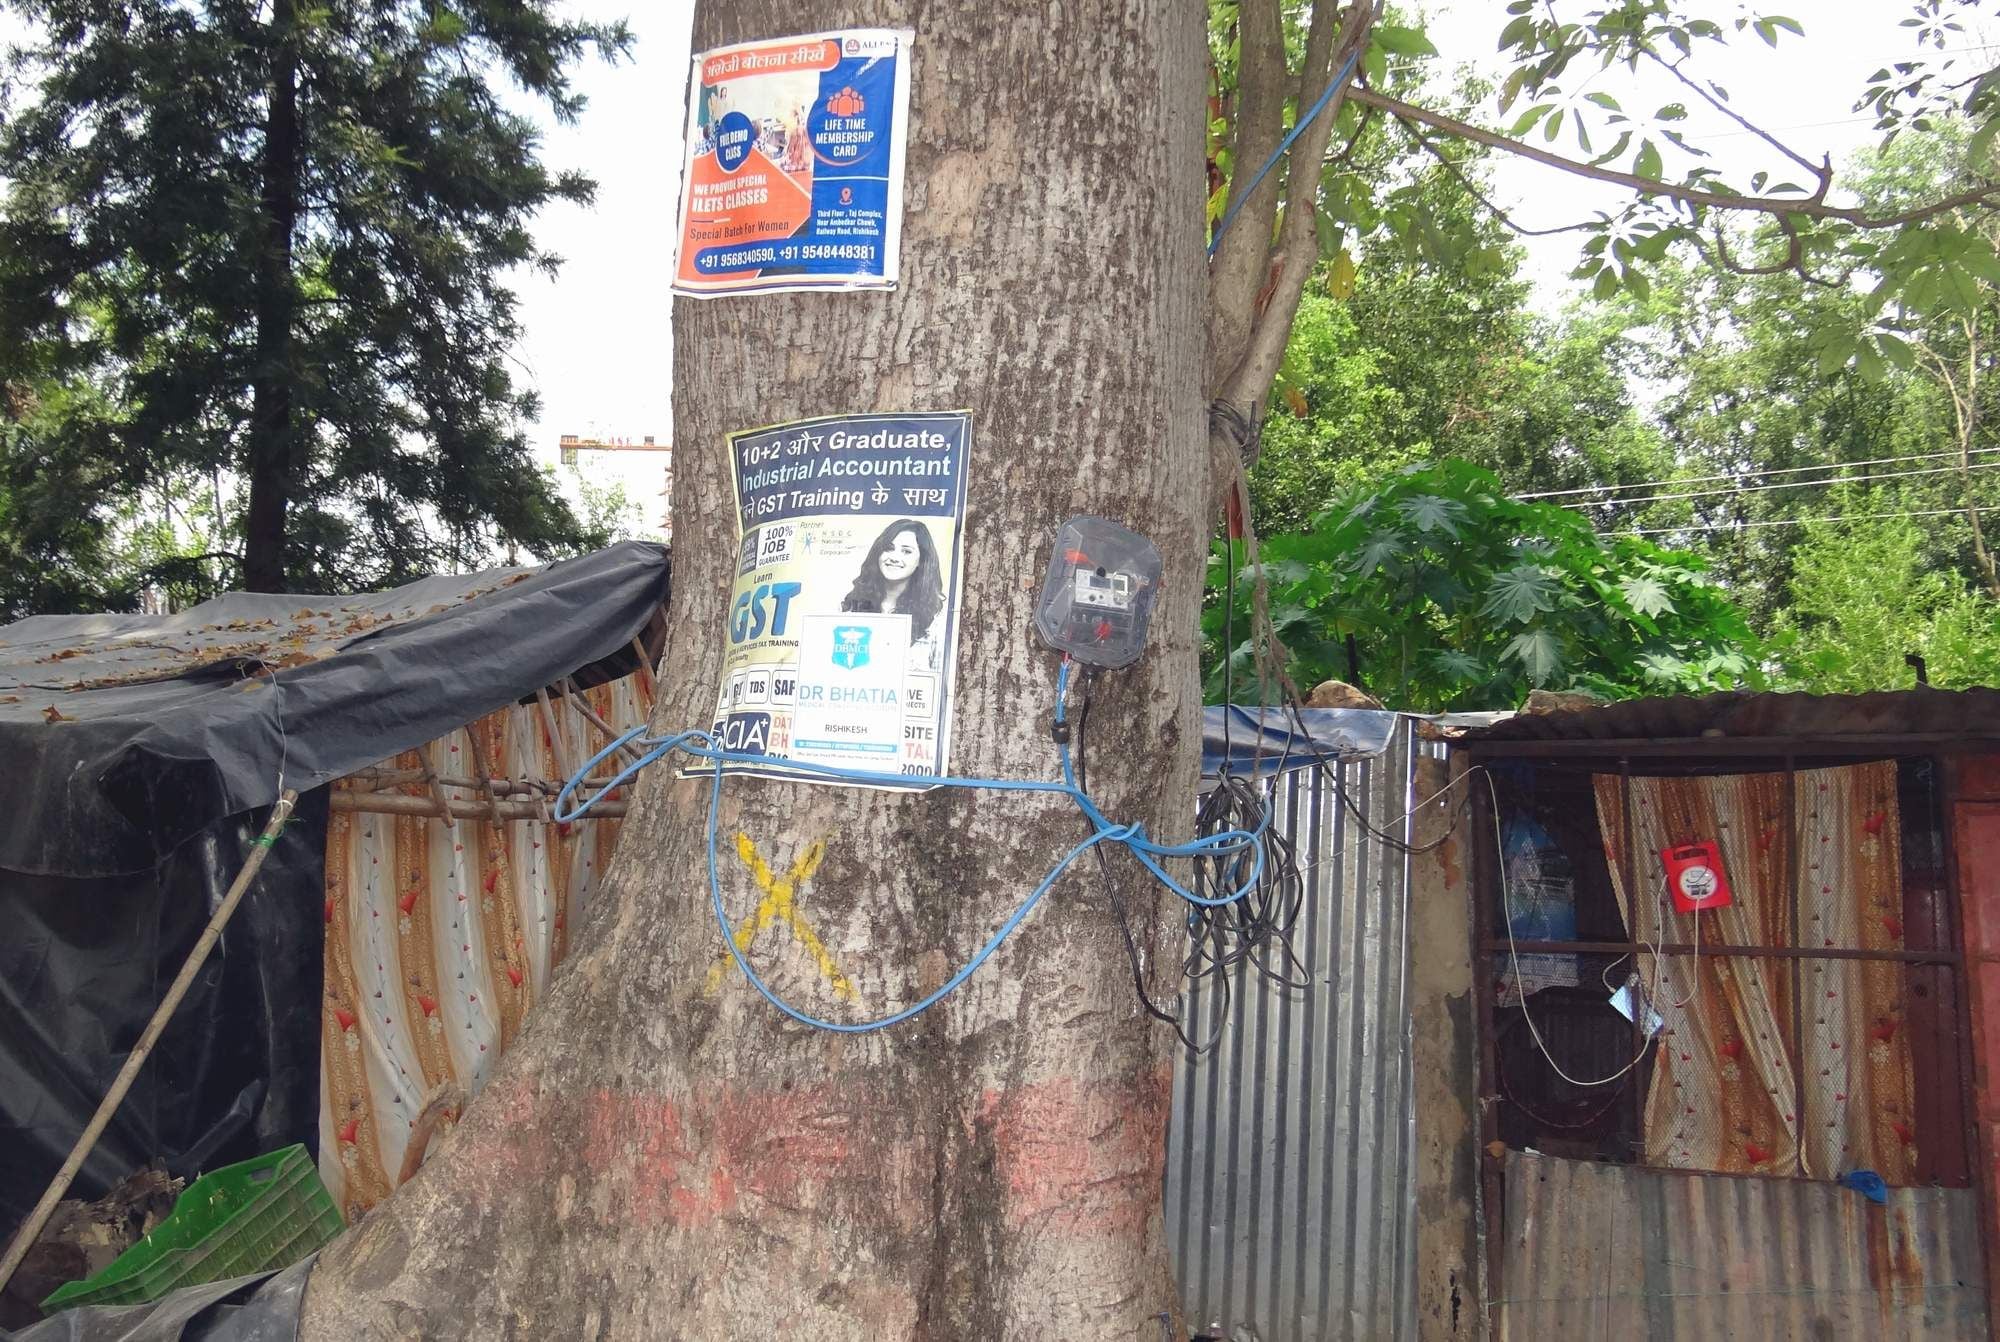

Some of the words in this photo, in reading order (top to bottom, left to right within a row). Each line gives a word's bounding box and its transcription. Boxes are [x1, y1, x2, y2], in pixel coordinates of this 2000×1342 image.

[742, 52, 787, 69] बोलना
[790, 45, 826, 64] सीखें
[825, 119, 843, 130] LIFE
[845, 118, 866, 130] TIME
[815, 131, 875, 145] MEMBERSHIP
[833, 145, 857, 157] CARD
[694, 183, 709, 195] WE
[709, 179, 736, 194] PROVIDE
[737, 174, 767, 188] SPECIAL
[725, 188, 768, 210] CLASSES
[690, 227, 722, 241] Special
[724, 225, 743, 238] Batch
[744, 224, 755, 234] For
[758, 221, 789, 232] Women
[700, 255, 718, 268] +91
[779, 247, 798, 260] +91
[802, 246, 875, 260] 9548448381
[742, 441, 781, 466] 10+2
[787, 431, 824, 456] और
[829, 430, 951, 451] Graduate,
[743, 459, 814, 493] Industrial
[817, 456, 951, 478] Accountant
[757, 493, 787, 515] GST
[791, 488, 864, 509] Training
[871, 481, 891, 504] के
[902, 487, 948, 506] साथ
[765, 526, 793, 541] 100%
[762, 539, 786, 556] JOB
[758, 554, 790, 566] GUARANTEE
[753, 572, 773, 585] Learn
[730, 582, 802, 644] GST
[768, 640, 799, 648] TRAINING
[750, 681, 765, 694] TDS
[799, 685, 824, 701] DR
[830, 686, 898, 704] BHATIA
[824, 724, 868, 735] RISHIKESH
[904, 726, 934, 740] SITE
